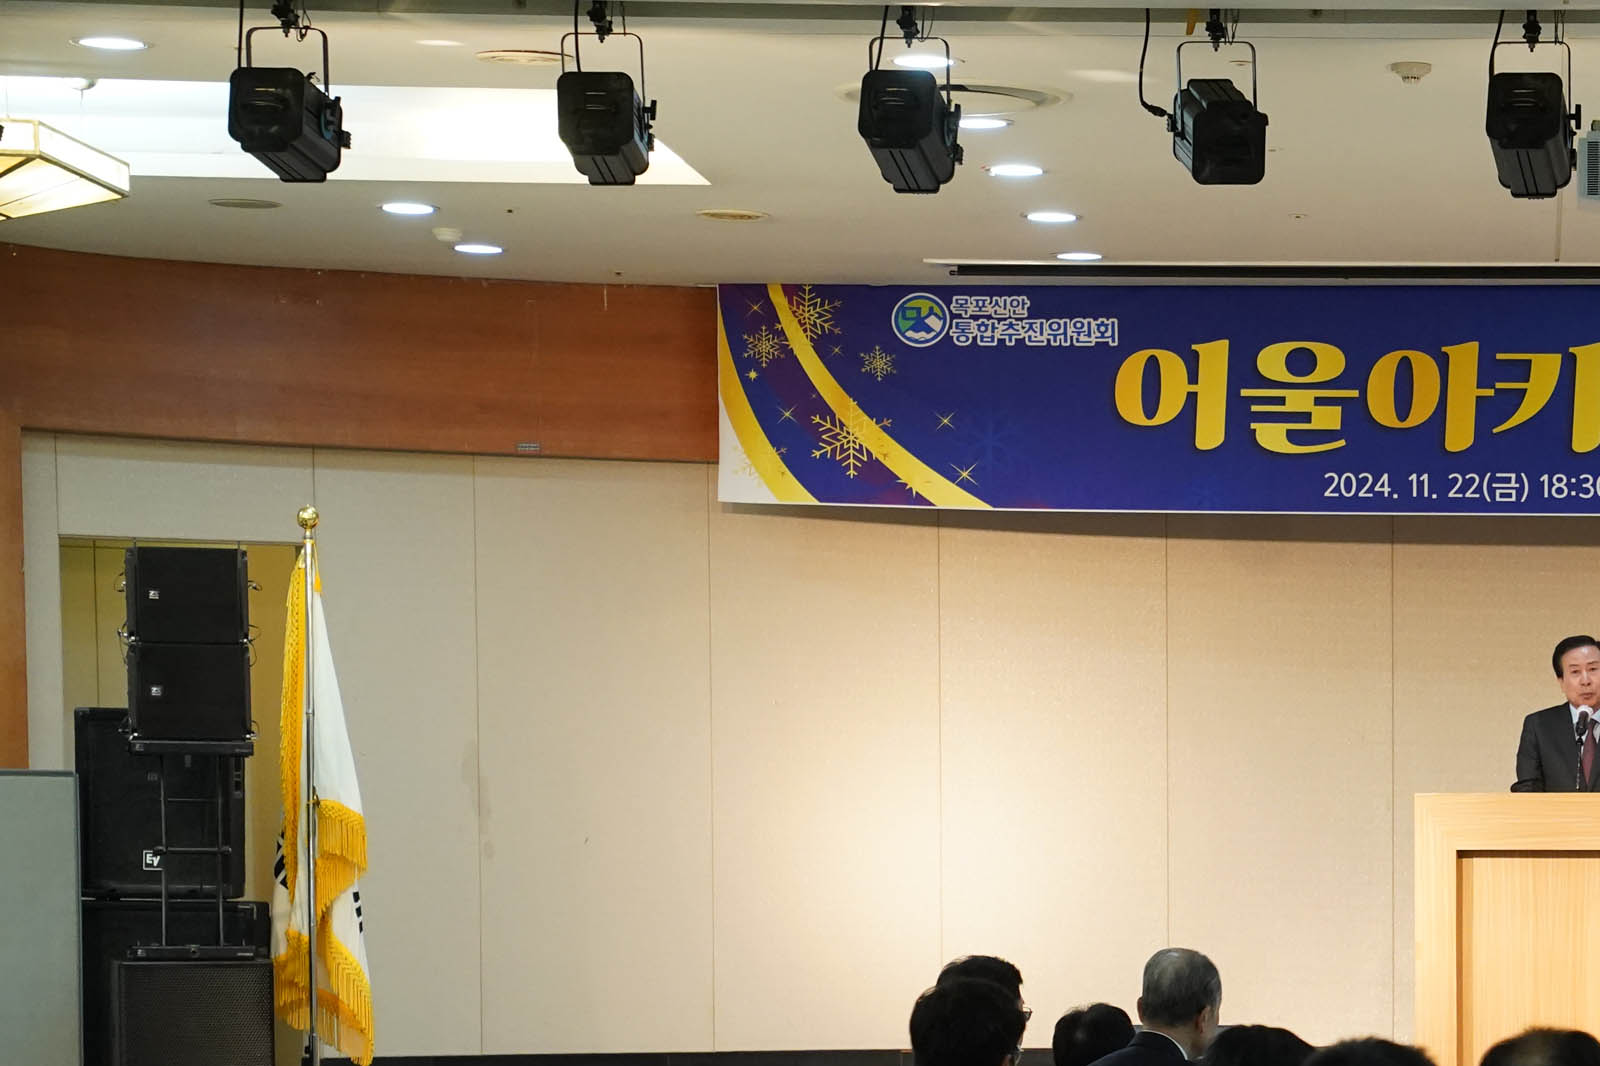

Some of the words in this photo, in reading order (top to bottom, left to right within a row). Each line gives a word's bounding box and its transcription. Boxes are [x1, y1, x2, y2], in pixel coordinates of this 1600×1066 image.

[951, 296, 1030, 318] 목포신안
[951, 318, 1118, 347] 통합추진위원회
[1323, 472, 1399, 499] 2024.
[1408, 473, 1438, 499] 11.
[1447, 472, 1530, 502] 22(금)
[146, 853, 161, 867] EV
